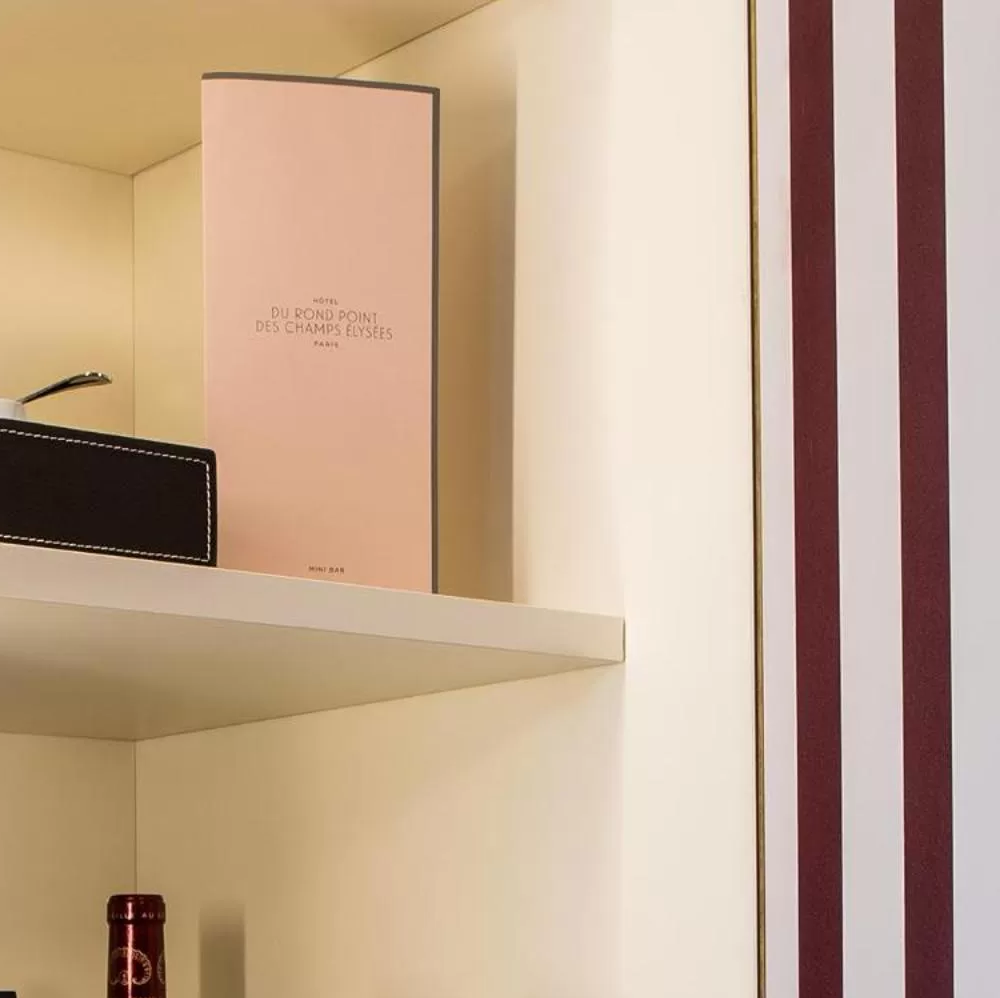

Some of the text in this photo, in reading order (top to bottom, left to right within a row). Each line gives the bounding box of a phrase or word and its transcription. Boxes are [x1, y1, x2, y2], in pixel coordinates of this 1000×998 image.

[271, 306, 378, 325] DU ROND POINT
[255, 320, 394, 341] DES CHAMPS ÉLYSÉES
[313, 340, 340, 349] PARIS
